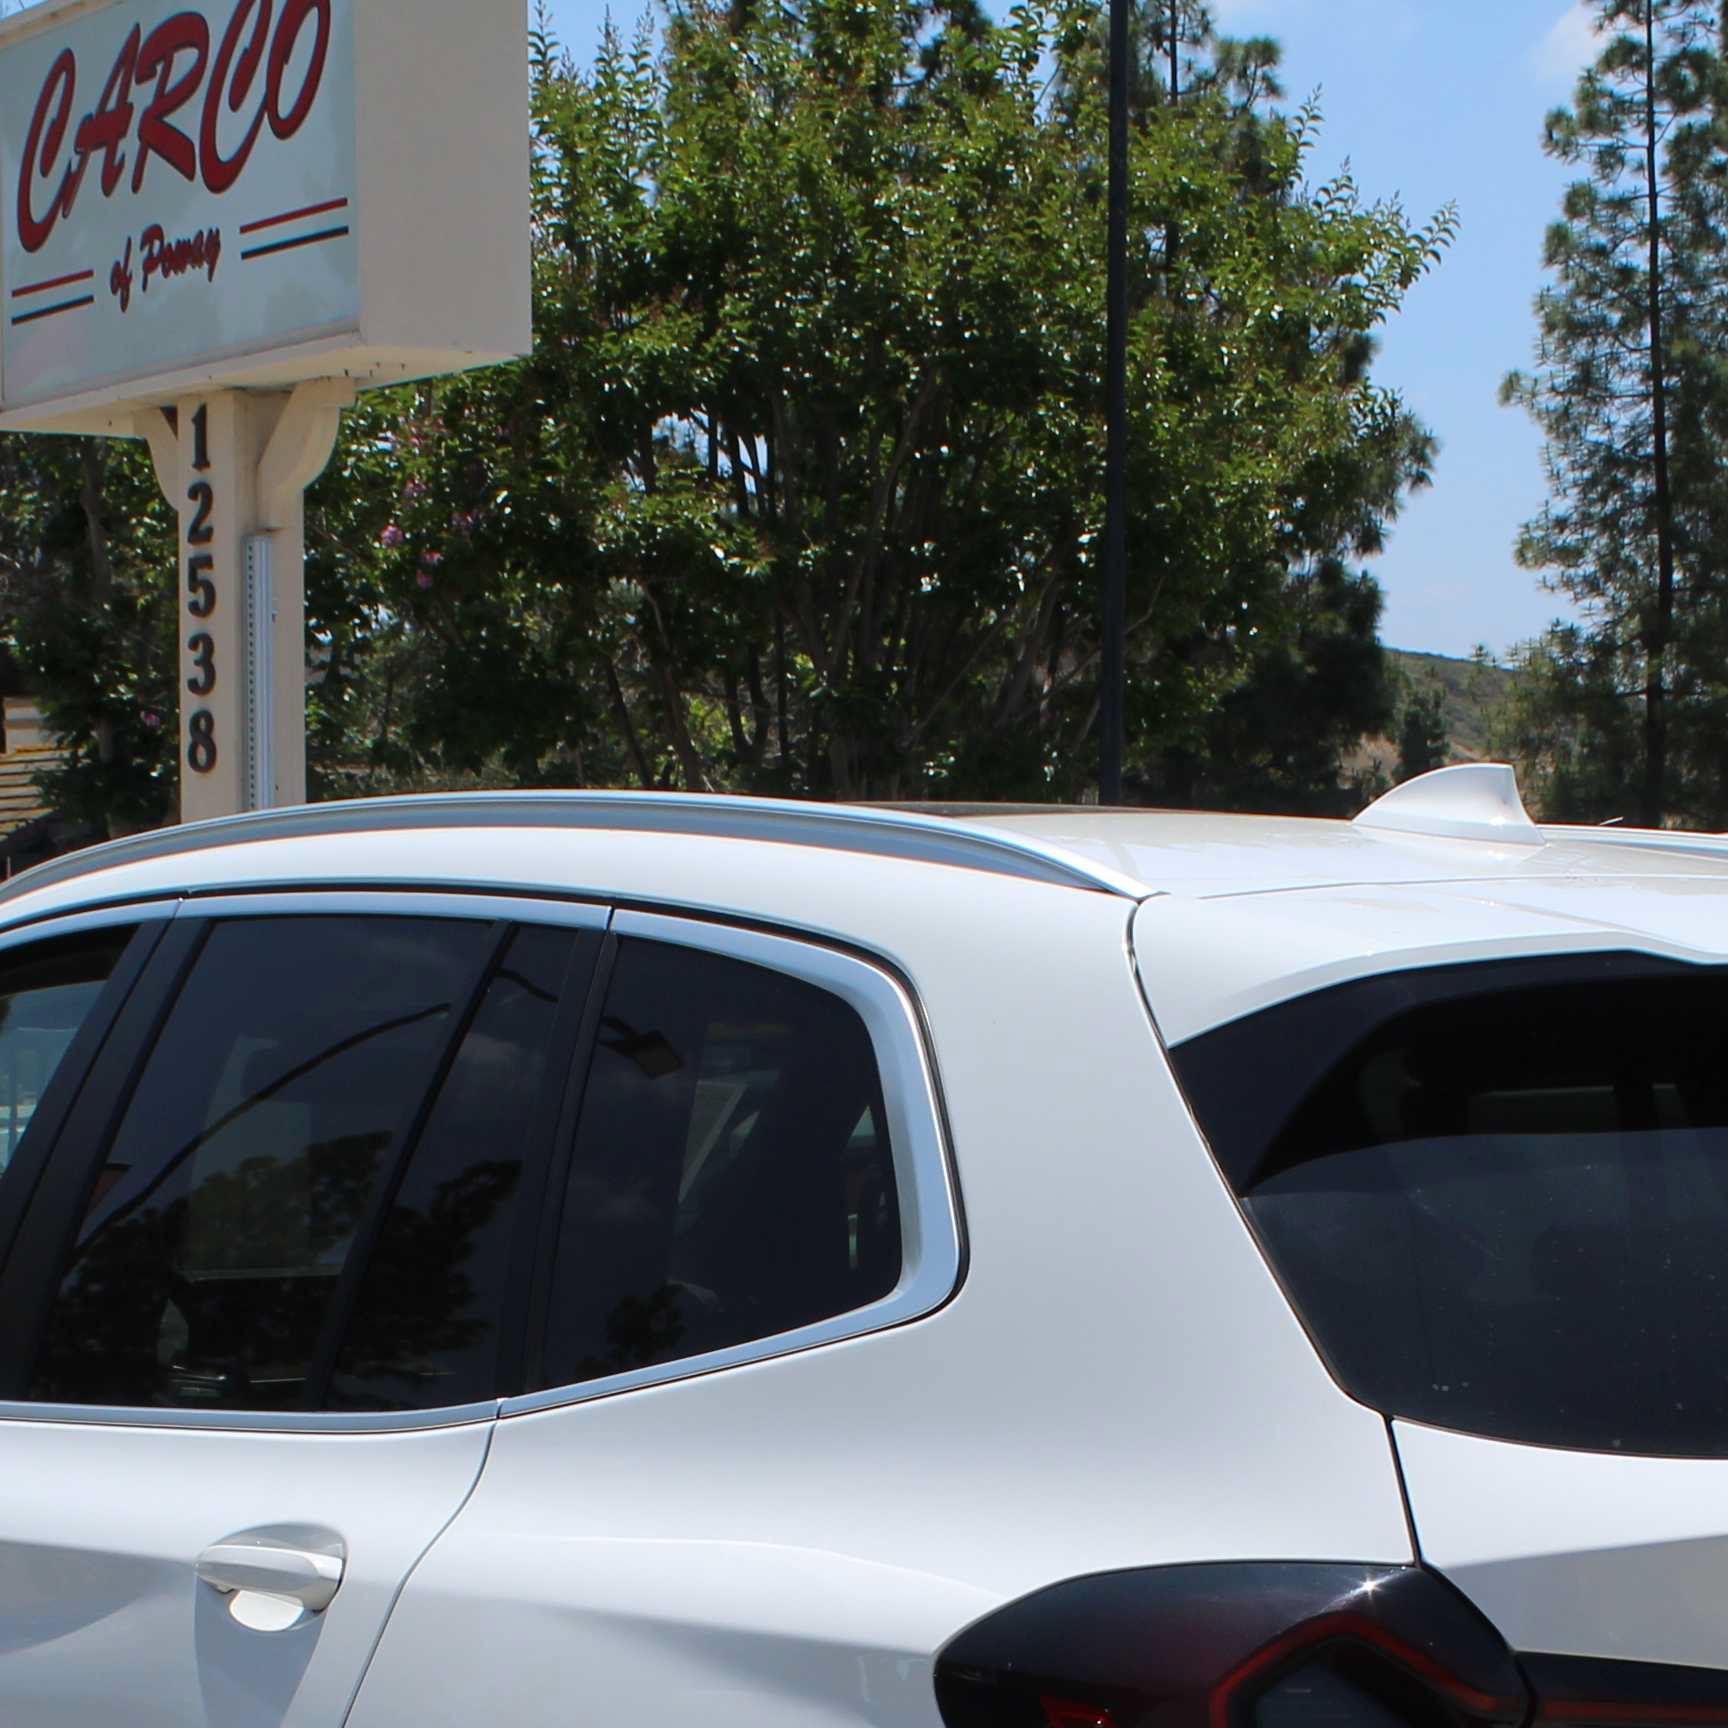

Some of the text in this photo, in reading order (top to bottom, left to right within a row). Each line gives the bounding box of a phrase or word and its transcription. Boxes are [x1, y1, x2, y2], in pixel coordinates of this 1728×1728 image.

[18, 0, 330, 252] CARCO
[110, 223, 221, 313] of Poway
[187, 402, 217, 774] 12538
